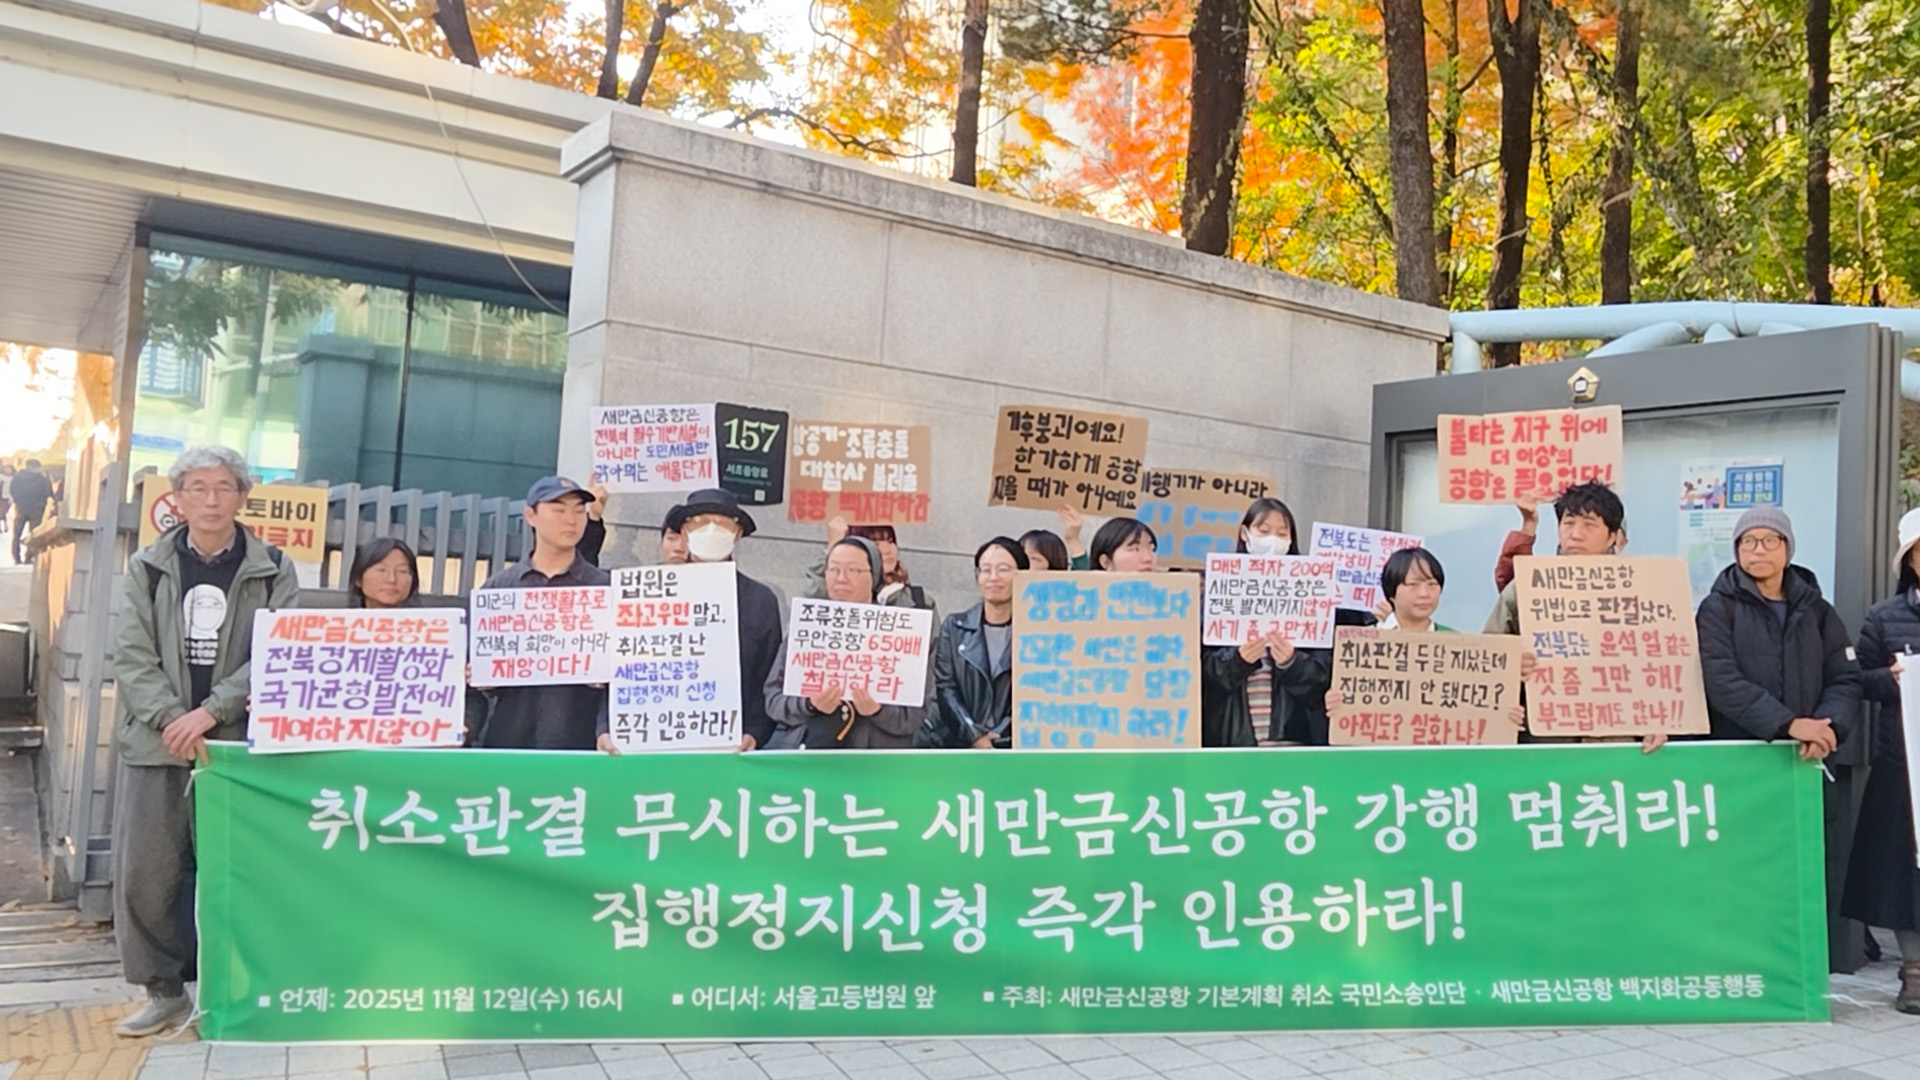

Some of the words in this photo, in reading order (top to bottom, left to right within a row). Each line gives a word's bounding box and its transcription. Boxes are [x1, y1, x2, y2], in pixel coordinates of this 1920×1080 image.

[601, 407, 700, 425] 새만금신공항은
[1007, 411, 1125, 444] 기후붕괴예요!
[723, 417, 780, 453] 157
[1450, 418, 1505, 456] 불타는
[1512, 415, 1551, 443] 지구
[1560, 413, 1607, 441] 위에
[597, 446, 640, 460] 아니라
[646, 441, 710, 458] 도민세금만
[1014, 446, 1101, 474] 한가하게
[1105, 456, 1142, 484] 공항
[1490, 448, 1510, 465] 더
[1516, 445, 1573, 468] 이상의
[655, 457, 713, 482] 애물단지
[800, 460, 868, 492] 대참사
[1449, 467, 1506, 501] 공항은
[1027, 476, 1069, 499] 때가
[1212, 477, 1269, 499] 아니라
[235, 497, 316, 522] 토바이
[838, 490, 932, 523] 백지화하라
[1318, 528, 1371, 553] 전북도는
[1211, 558, 1242, 575] 매년
[1248, 558, 1285, 577] 적자
[1289, 560, 1335, 580] 200억
[1531, 565, 1634, 590] 새만금신공항
[620, 569, 678, 599] 법원은
[476, 591, 516, 611] 미군의
[524, 589, 608, 613] 전쟁활주로
[616, 601, 690, 627] 좌고우면
[1530, 597, 1592, 622] 위법으로
[1597, 595, 1677, 626] 판결났다.
[269, 614, 450, 645] 새만금신공항은
[477, 612, 594, 633] 새만금신공항은
[1206, 619, 1240, 638] 사기
[476, 634, 519, 657] 전북의
[525, 633, 565, 655] 희망이
[571, 631, 611, 654] 아니라
[616, 631, 683, 657] 취소판결
[689, 632, 707, 656] 난
[794, 628, 866, 652] 무안공항
[867, 633, 923, 657] 650배
[1340, 639, 1410, 673] 취소판결
[1451, 648, 1507, 674] 지났는데
[1532, 629, 1591, 659] 전북도는
[1664, 632, 1692, 657] 같은
[264, 645, 455, 683] 전북경제활성화
[492, 653, 592, 680] 재앙이다!
[614, 660, 700, 682] 새만금신공항
[792, 651, 901, 676] 새만금신공항
[617, 683, 680, 706] 집행정지
[686, 680, 717, 702] 신청
[1339, 675, 1411, 706] 집행정지
[1420, 678, 1436, 706] 안
[1440, 680, 1506, 711] 됐다고?
[1534, 664, 1556, 696] 짓
[1562, 665, 1582, 696] 좀
[1591, 663, 1633, 694] 그만
[1641, 661, 1683, 694] 해!
[259, 677, 457, 716] 국가균형발전에
[615, 711, 650, 745] 즉각
[657, 709, 738, 742] 인용하라!
[1338, 711, 1404, 744] 아직도?
[1536, 701, 1627, 732] 부끄럽지도
[307, 785, 587, 859] 취소판결
[616, 787, 899, 861] 무시하는
[921, 784, 1329, 859] 새만금신공항
[1354, 782, 1479, 854] 강행
[1507, 778, 1720, 851] 멈춰라!
[592, 882, 988, 955] 집행정지신청
[1016, 880, 1157, 953] 즉각
[1182, 876, 1466, 951] 인용하라!
[279, 987, 336, 1013] 언제:
[343, 987, 425, 1012] 2025년
[432, 986, 476, 1012] 11월
[482, 986, 570, 1012] 12일(수)
[576, 986, 624, 1012] 16시
[691, 985, 766, 1011] 어디서:
[773, 984, 908, 1011] 서울고등법원
[913, 984, 937, 1010] 앞
[1002, 985, 1053, 1009] 주최:
[1059, 985, 1192, 1008] 새만금신공항
[1197, 983, 1285, 1008] 기본계획
[1290, 982, 1334, 1007] 취소
[1340, 980, 1467, 1007] 국민소송인단
[1490, 977, 1614, 1004] 새만금신공항
[1618, 973, 1766, 1001] 백지화공동행동
